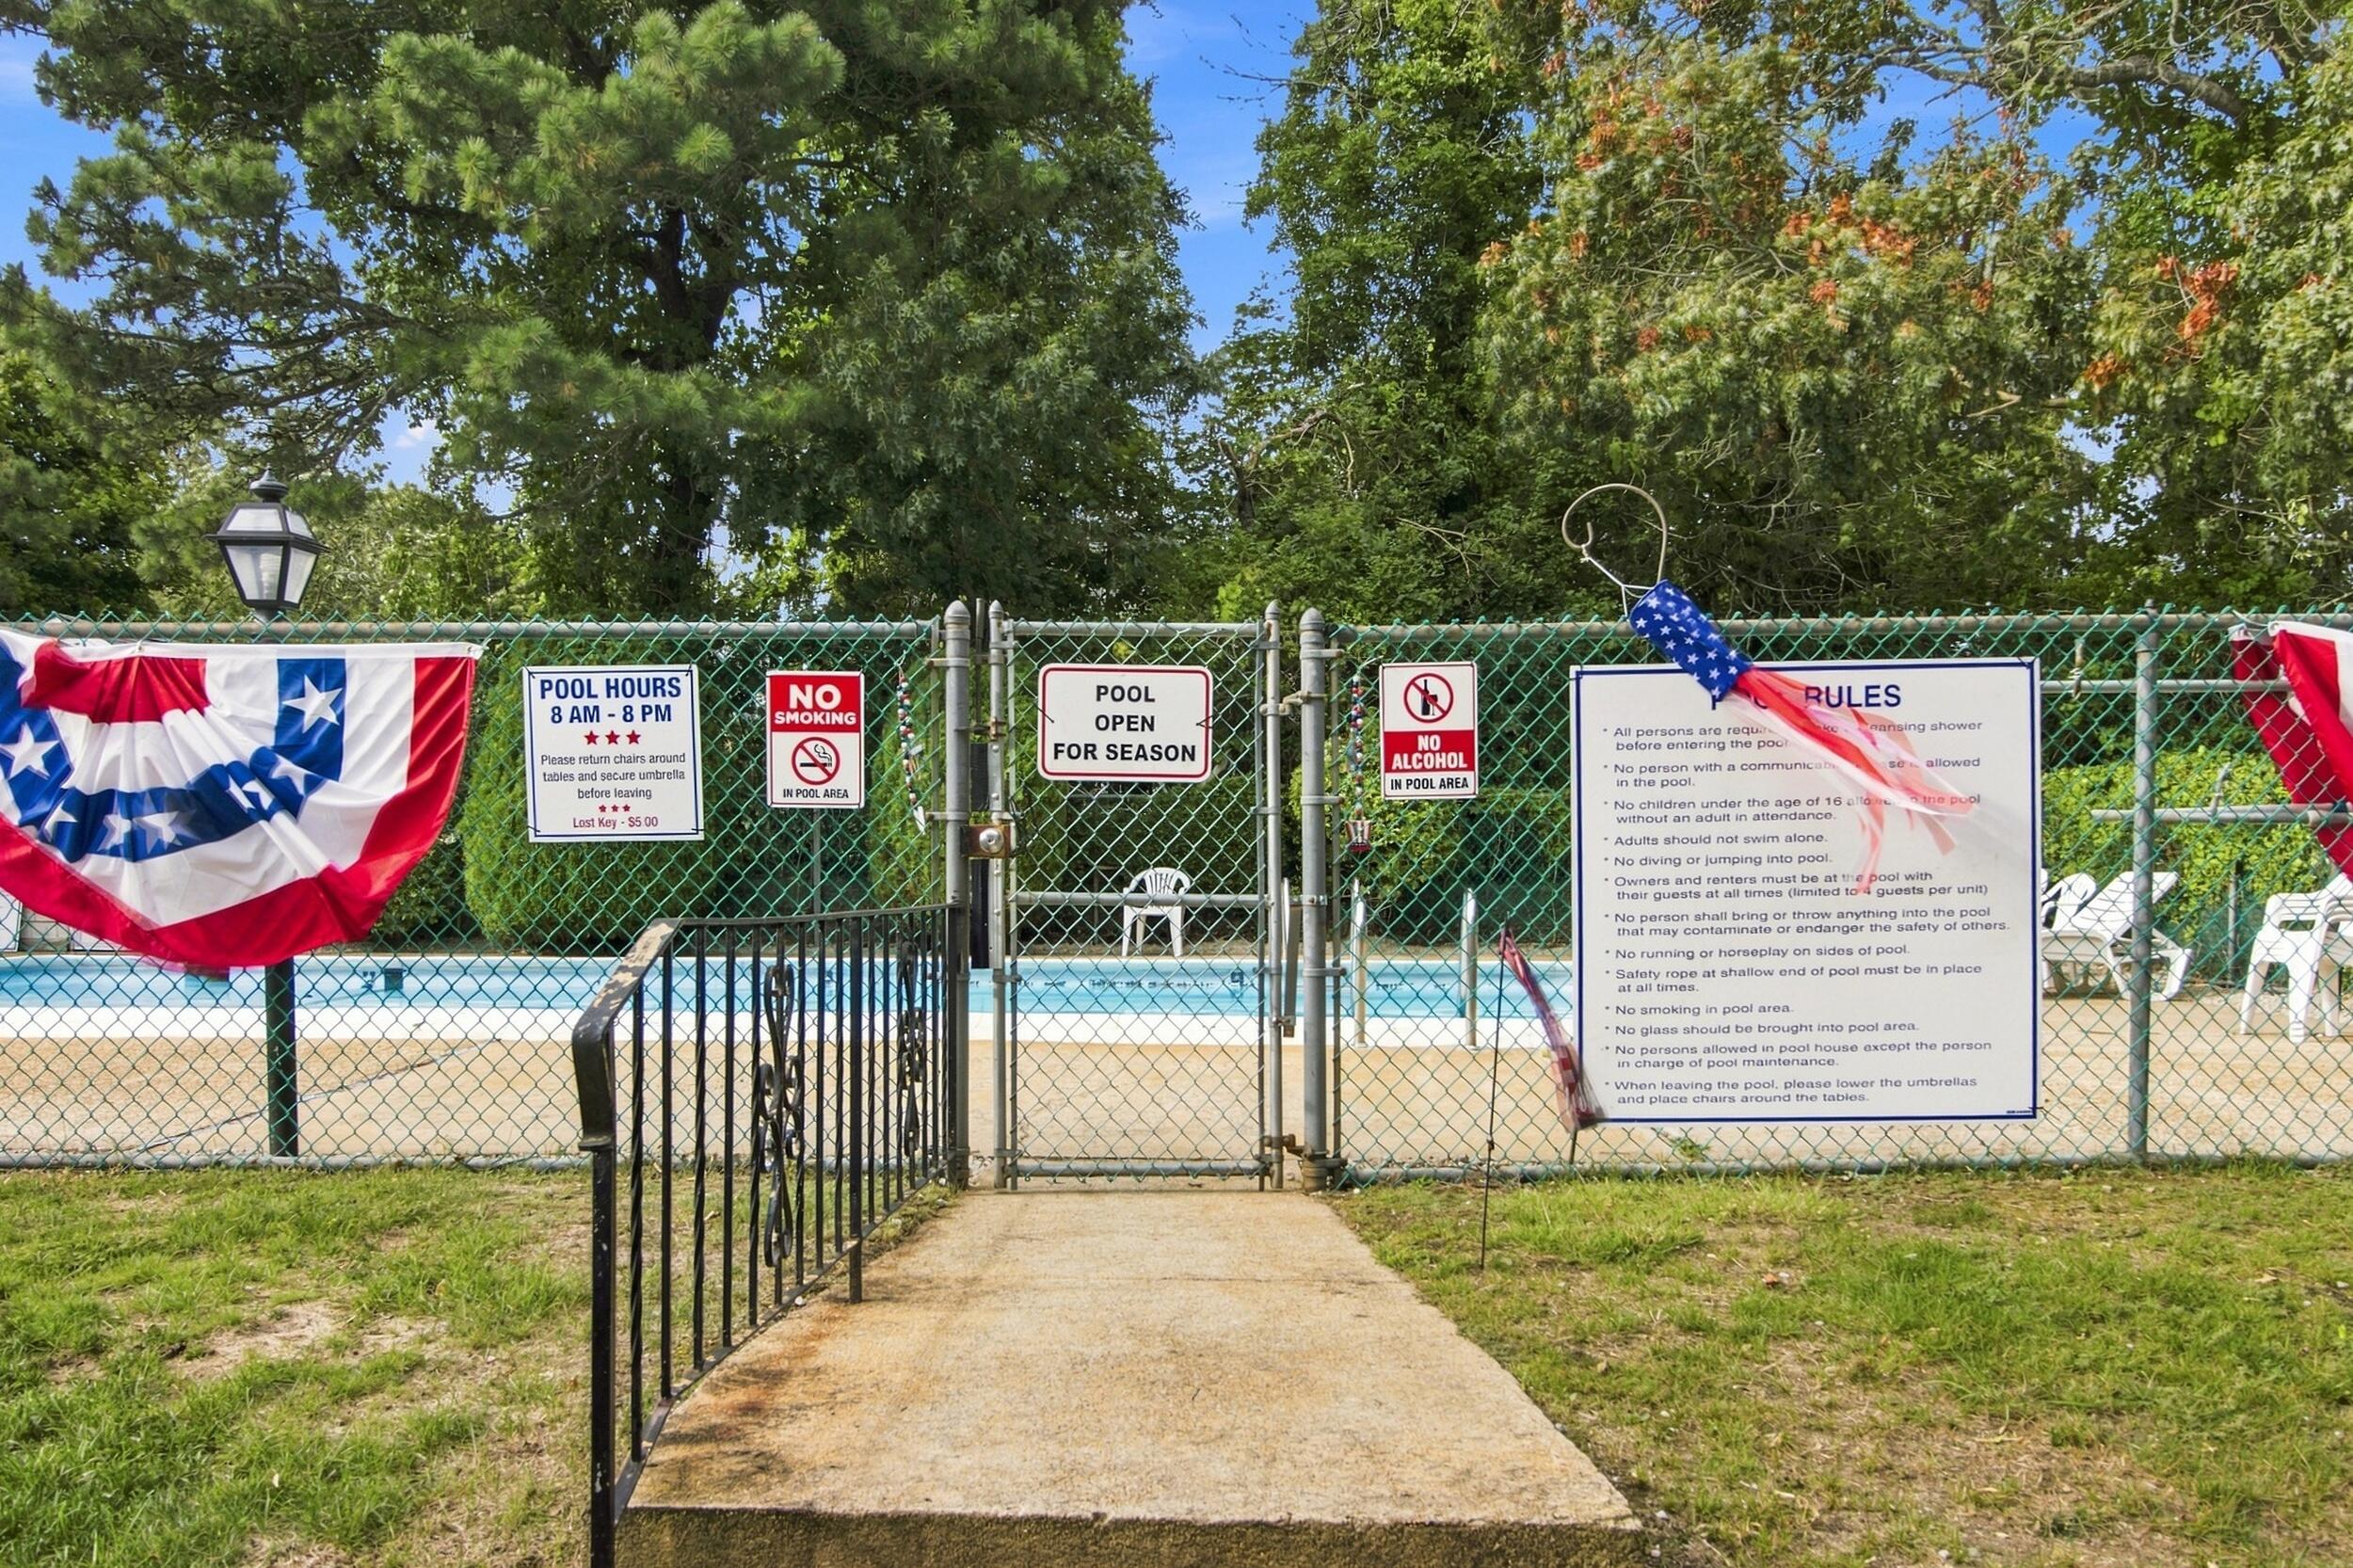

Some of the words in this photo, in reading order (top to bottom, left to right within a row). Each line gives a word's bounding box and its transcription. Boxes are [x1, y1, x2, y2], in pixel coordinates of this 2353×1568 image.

[539, 678, 599, 700] POOL
[604, 676, 681, 699] HOURS
[1096, 684, 1156, 703] POOL
[789, 683, 842, 710] NO
[1805, 684, 1901, 708] RULES
[550, 705, 563, 725] 8
[568, 704, 600, 724] AM
[621, 704, 635, 724] 8
[640, 703, 672, 723] PM
[774, 711, 856, 726] SMOKING
[1095, 713, 1156, 733] OPEN
[1613, 728, 1631, 737] All
[1636, 727, 1693, 739] persons
[1699, 728, 1722, 736] are
[1930, 721, 1982, 731] shower
[1417, 735, 1442, 751] NO
[1615, 740, 1662, 751] before
[1666, 741, 1726, 752] entering
[1729, 739, 1753, 749] the
[540, 754, 576, 766] Please
[578, 754, 611, 765] return
[613, 752, 647, 765] chairs
[648, 752, 686, 764] around
[1053, 742, 1098, 760] FOR
[1105, 743, 1196, 762] SEASON
[1391, 750, 1468, 771] ALCOHOL
[1613, 764, 1634, 774] No
[1639, 764, 1689, 776] person
[1693, 762, 1722, 772] with
[1727, 763, 1736, 772] a
[1926, 758, 1980, 768] allowed
[542, 771, 576, 783] tables
[577, 770, 598, 782] and
[600, 771, 636, 782] secure
[638, 768, 686, 781] umbrella
[1616, 778, 1629, 788] in
[1632, 776, 1657, 788] the
[1659, 776, 1695, 790] pool.
[1390, 778, 1402, 791] IN
[1405, 777, 1436, 791] POOL
[1438, 776, 1469, 790] AREA
[577, 787, 612, 800] before
[614, 787, 652, 801] leaving
[782, 788, 793, 799] IN
[794, 788, 821, 799] POOL
[823, 788, 850, 799] AREA
[1614, 800, 1635, 810] No
[1639, 800, 1696, 810] children
[1701, 799, 1742, 809] under
[1747, 798, 1770, 808] the
[1774, 798, 1801, 809] age
[1806, 796, 1820, 807] of
[1827, 797, 1842, 807] 16
[1950, 793, 1981, 806] pool
[572, 817, 596, 829] Lost
[597, 816, 617, 830] Key
[1616, 814, 1669, 824] without
[1672, 814, 1691, 824] an
[1694, 812, 1731, 824] adult
[1735, 812, 1748, 822] in
[1752, 810, 1836, 822] attendance.
[1613, 835, 1659, 847] Adults
[1663, 834, 1712, 846] should
[1716, 834, 1739, 844] not
[1743, 834, 1781, 844] swim
[1784, 832, 1829, 843] alone.
[1613, 856, 1635, 867] No
[1639, 856, 1682, 868] diving
[1686, 856, 1701, 865] or
[1704, 854, 1763, 867] jumping
[1766, 854, 1794, 864] into
[1797, 852, 1833, 866] pool.
[1614, 876, 1670, 887] Owners
[1674, 875, 1702, 885] and
[1706, 875, 1757, 885] renters
[1762, 874, 1797, 884] must
[1801, 873, 1819, 884] be
[1824, 873, 1837, 883] at
[1842, 873, 1864, 882] the
[1869, 872, 1899, 884] pool
[1904, 872, 1933, 881] with
[1616, 890, 1649, 901] their
[1653, 889, 1702, 903] guests
[1705, 888, 1720, 899] at
[1723, 888, 1740, 899] all
[1743, 888, 1784, 899] times
[1787, 887, 1841, 899] (limited
[1845, 888, 1858, 896] to
[1875, 885, 1925, 899] guests
[1928, 886, 1953, 897] per
[1957, 884, 1989, 897] unit)
[1615, 949, 1637, 960] No
[1641, 948, 1695, 961] running
[1699, 950, 1714, 959] or
[1718, 946, 1789, 959] horseplay
[1792, 948, 1812, 957] on
[1815, 946, 1854, 956] sides
[1857, 945, 1872, 956] of
[1875, 944, 1911, 957] pool.
[1615, 968, 1661, 982] Safety
[1665, 970, 1698, 981] rope
[1702, 968, 1717, 979] at
[1720, 967, 1775, 978] shallow
[1778, 967, 1806, 977] end
[1810, 966, 1825, 977] of
[1828, 966, 1860, 979] pool
[1864, 965, 1899, 976] must
[1903, 964, 1922, 975] be
[1926, 964, 1939, 974] in
[1943, 964, 1982, 976] place
[1617, 984, 1632, 994] at
[1635, 983, 1653, 993] all
[1656, 983, 1700, 993] times.
[1615, 1004, 1637, 1016] No
[1640, 1004, 1701, 1017] smoking
[1705, 1004, 1718, 1015] in
[1721, 1002, 1753, 1016] pool
[1757, 1004, 1794, 1014] area.
[1615, 1025, 1637, 1035] No
[1640, 1024, 1679, 1038] glass
[1682, 1024, 1731, 1035] should
[1735, 1023, 1753, 1034] be
[1757, 1022, 1814, 1035] brought
[1817, 1023, 1845, 1032] into
[1848, 1021, 1880, 1034] pool
[1882, 1022, 1919, 1032] area.
[1634, 1059, 1685, 1071] charge
[1689, 1057, 1704, 1068] of
[1706, 1058, 1738, 1070] pool
[1741, 1057, 1839, 1067] maintenance.
[1613, 1080, 1657, 1091] When
[1660, 1080, 1713, 1091] leaving
[1717, 1080, 1740, 1090] the
[1784, 1079, 1833, 1091] please
[1835, 1079, 1876, 1089] lower
[1880, 1078, 1903, 1088] the
[1906, 1077, 1977, 1088] umbrellas
[1617, 1094, 1645, 1105] and
[1648, 1094, 1689, 1106] place
[1691, 1093, 1737, 1104] chairs
[1739, 1093, 1792, 1103] around
[1795, 1093, 1818, 1103] the
[1822, 1092, 1870, 1103] tables.
